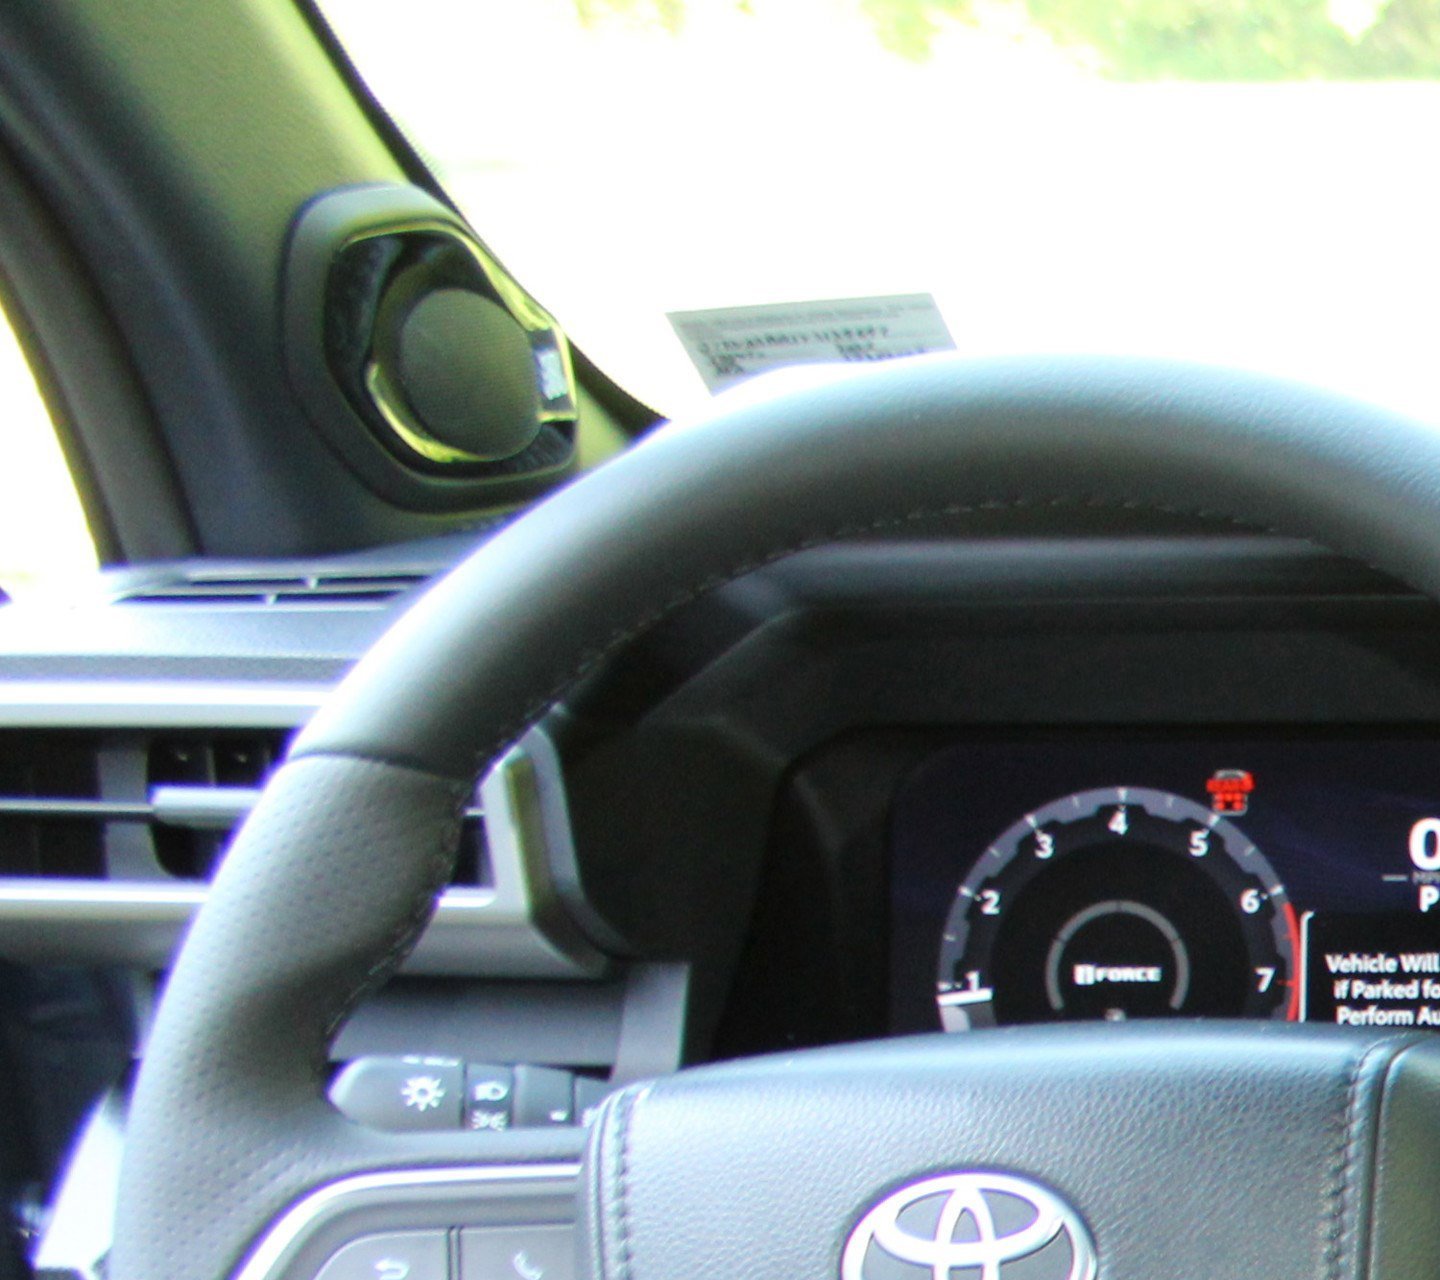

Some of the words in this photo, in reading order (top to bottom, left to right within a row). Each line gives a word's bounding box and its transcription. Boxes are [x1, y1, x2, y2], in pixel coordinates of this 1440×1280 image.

[1108, 809, 1129, 836] 4
[1034, 833, 1054, 859] 3
[1188, 830, 1209, 858] 5
[980, 889, 1001, 916] 2
[1240, 888, 1261, 914] 6
[1419, 885, 1440, 913] P
[1325, 952, 1398, 974] Vehicle
[1399, 952, 1440, 974] Will
[1255, 967, 1276, 993] 7
[1350, 978, 1419, 1000] Parked
[1335, 1005, 1414, 1026] Perform
